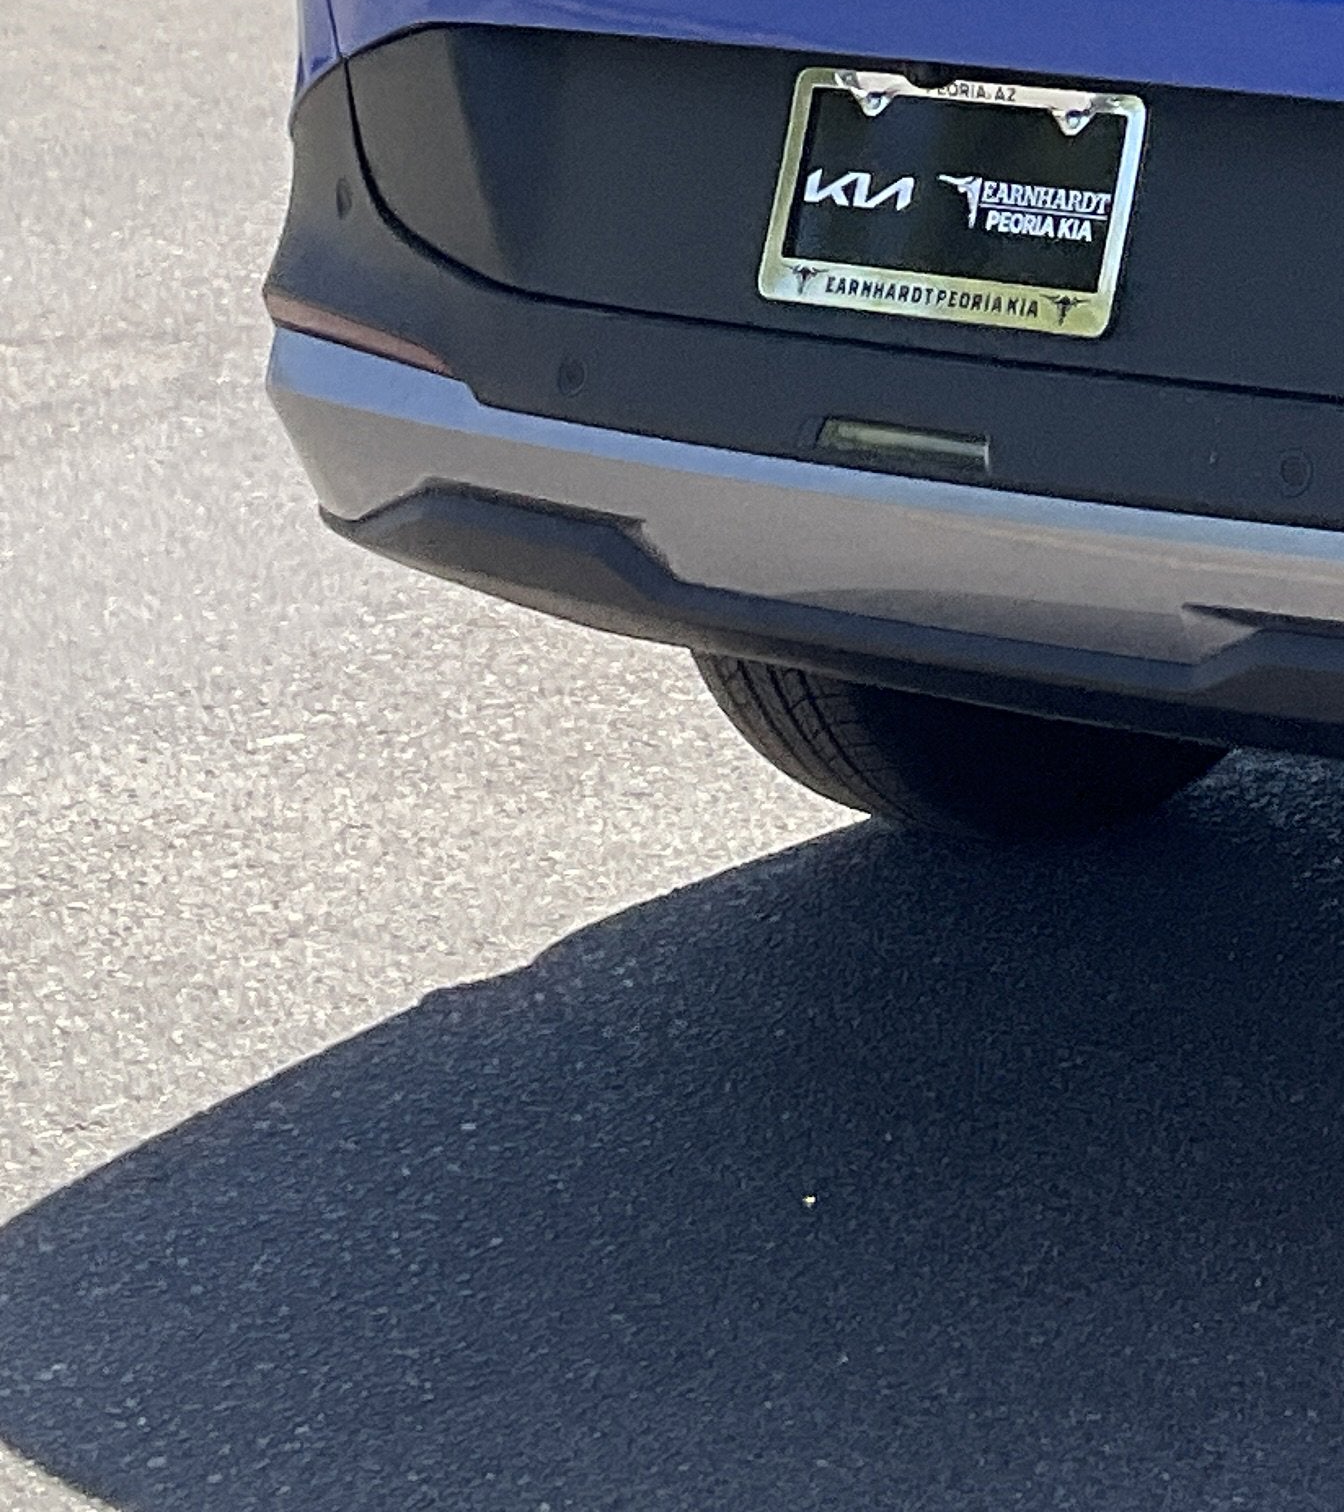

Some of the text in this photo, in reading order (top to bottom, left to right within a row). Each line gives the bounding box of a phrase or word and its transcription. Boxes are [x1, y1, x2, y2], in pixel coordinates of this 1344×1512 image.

[995, 86, 1017, 101] AZ
[803, 168, 915, 211] KIA
[981, 181, 1111, 214] EARNHARDT
[985, 210, 1092, 242] PEORIA KIA
[825, 276, 1039, 319] EARNHARDT PEORIA KIA
